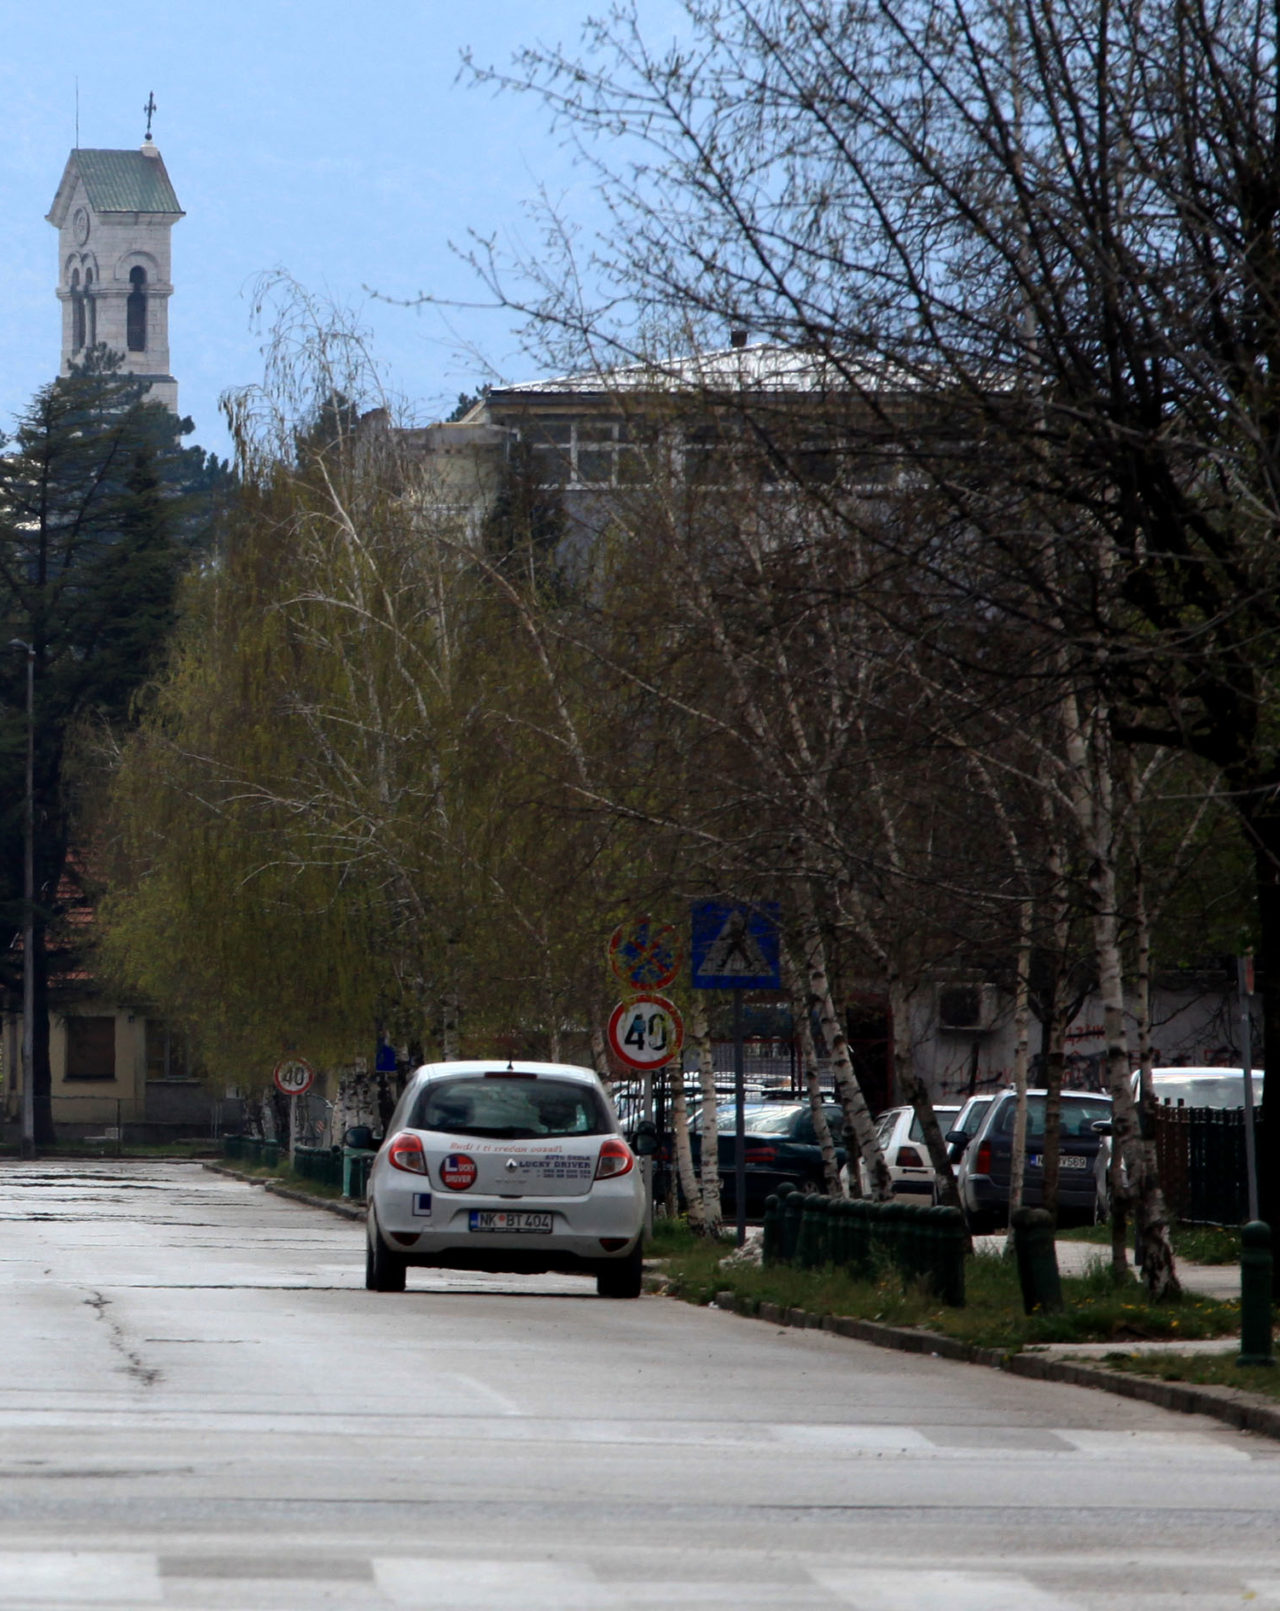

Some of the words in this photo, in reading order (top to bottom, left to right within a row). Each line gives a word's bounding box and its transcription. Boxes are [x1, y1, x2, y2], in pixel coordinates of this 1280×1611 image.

[624, 1013, 667, 1051] 40
[282, 1066, 305, 1086] 40
[554, 1161, 591, 1169] DRIVER
[479, 1214, 496, 1226] NK
